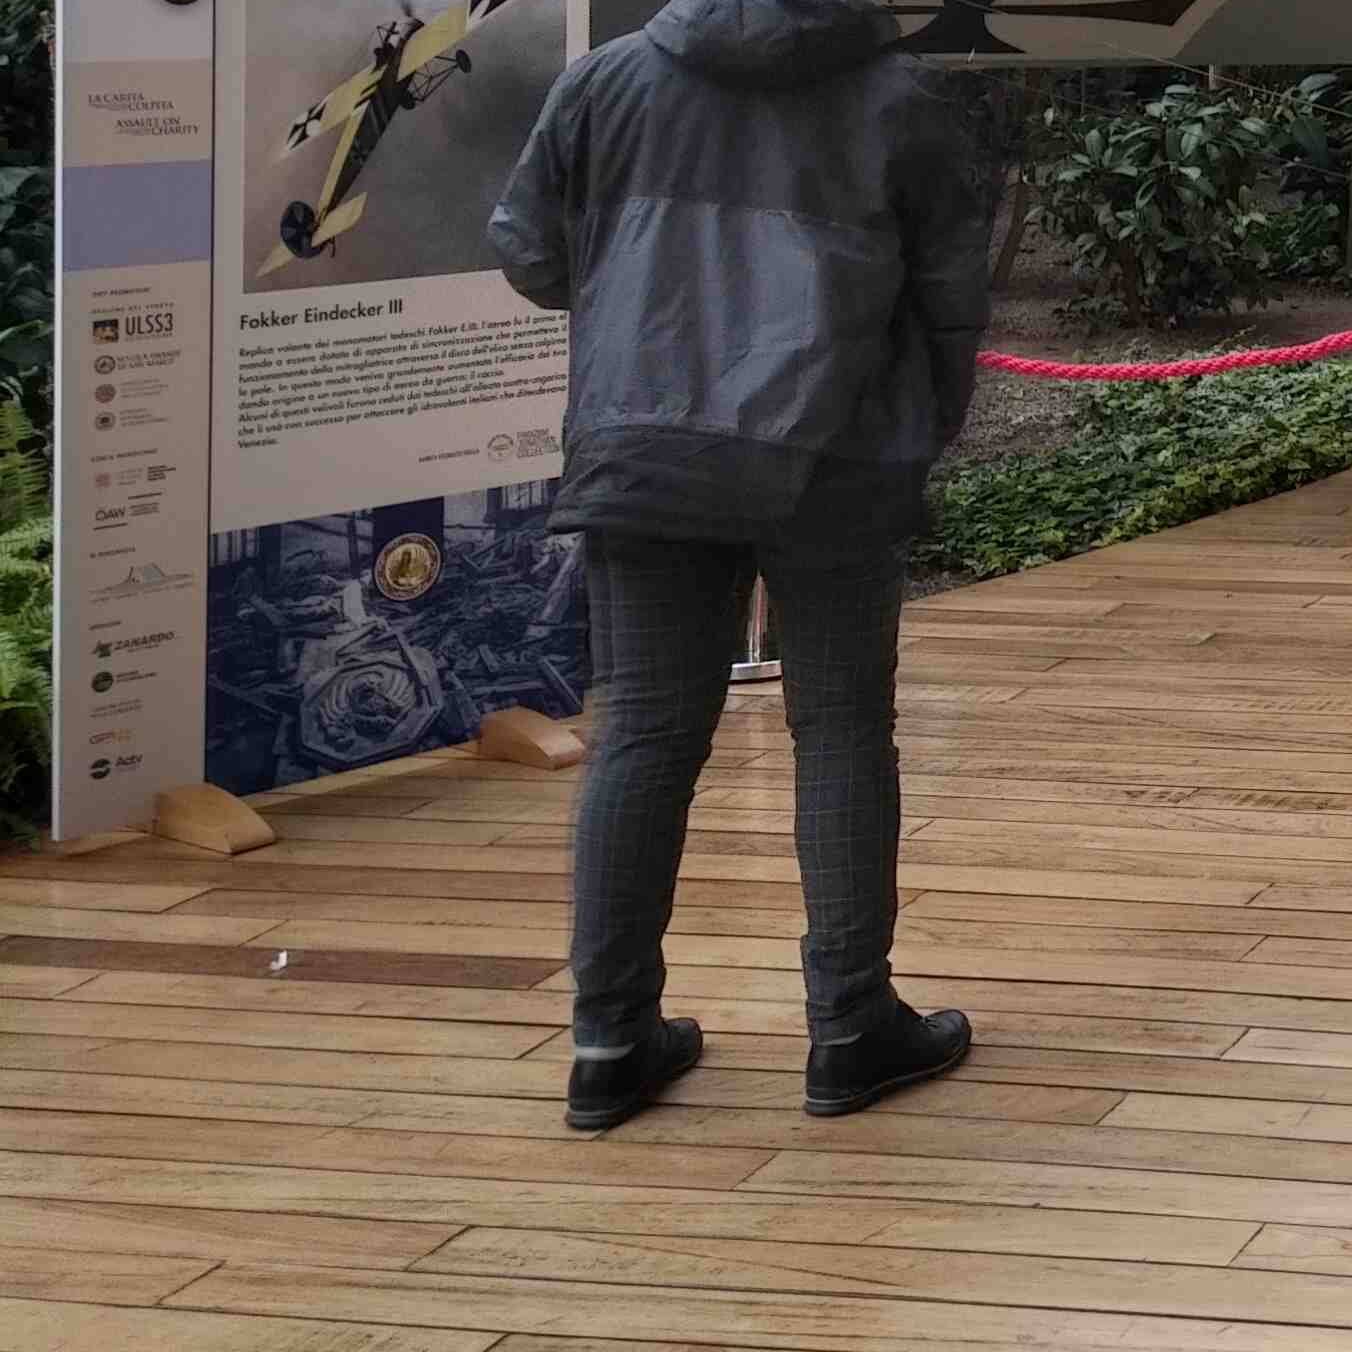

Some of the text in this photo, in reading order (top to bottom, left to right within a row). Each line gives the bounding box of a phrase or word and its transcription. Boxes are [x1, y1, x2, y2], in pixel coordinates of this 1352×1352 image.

[125, 313, 174, 336] ULSS3
[240, 298, 403, 330] Fokker Eindecker III
[428, 324, 457, 335] Fokker
